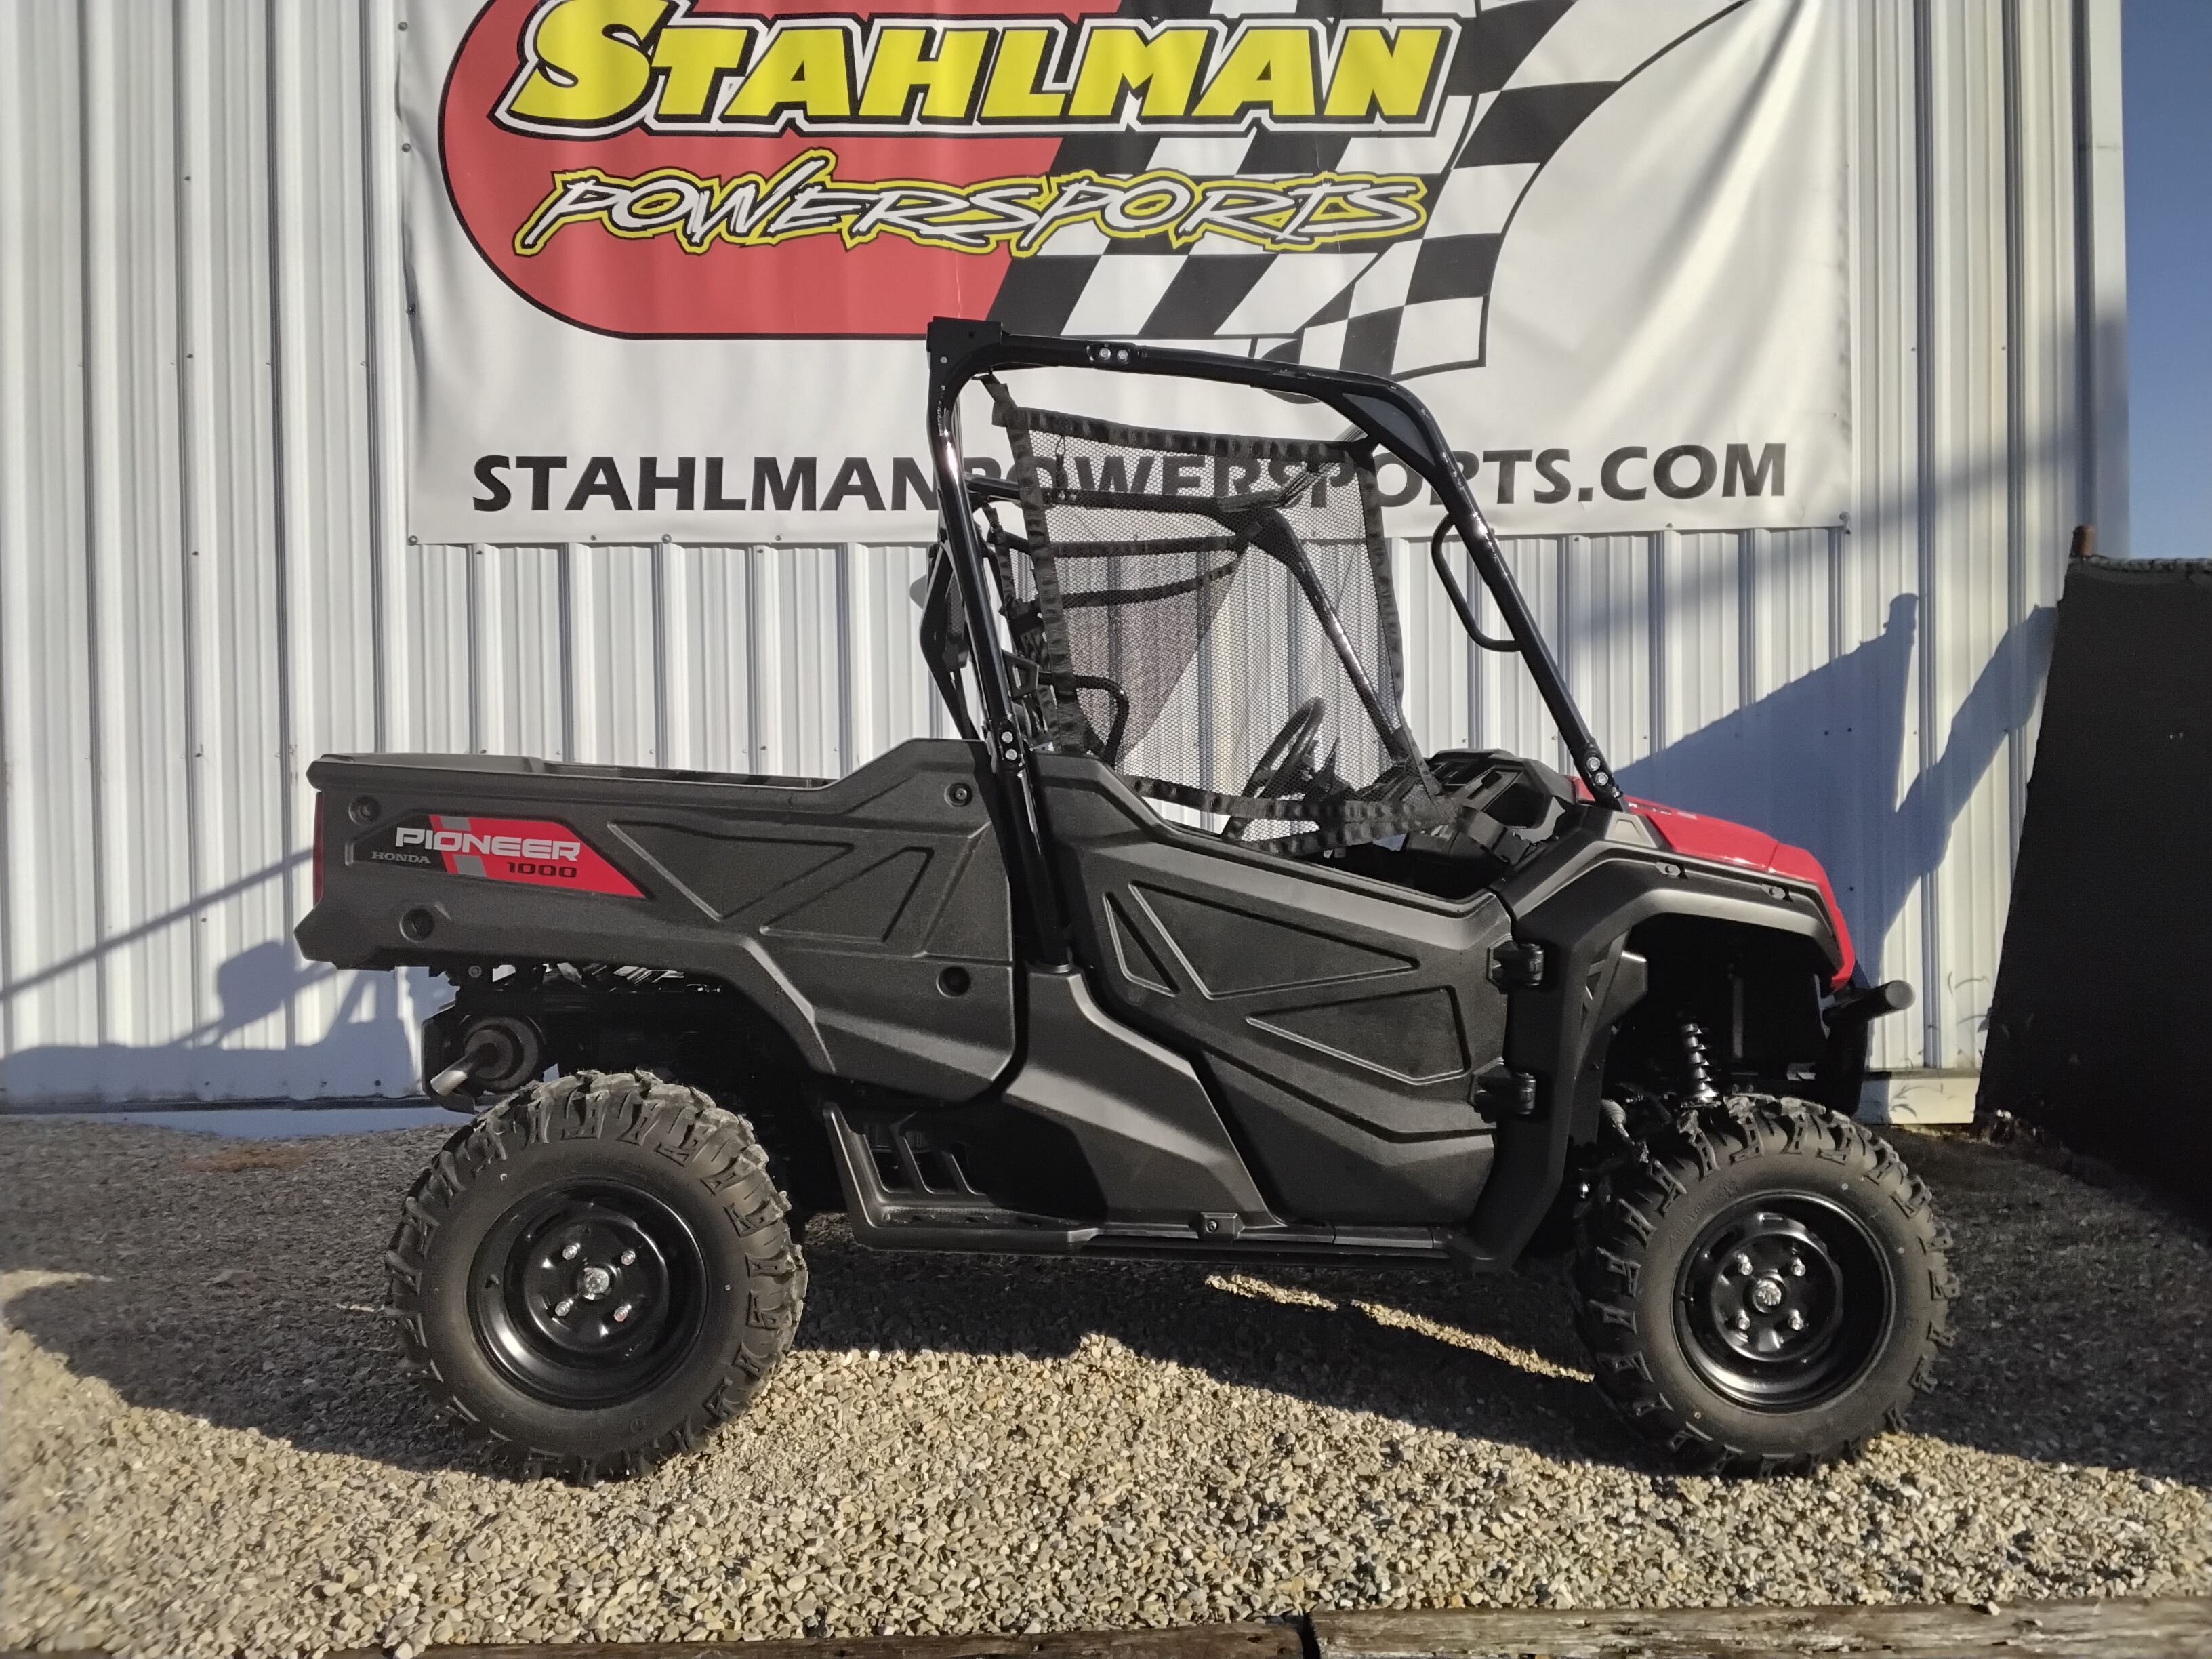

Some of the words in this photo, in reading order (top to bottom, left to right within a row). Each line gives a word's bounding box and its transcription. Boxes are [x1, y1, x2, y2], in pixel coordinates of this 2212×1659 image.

[498, 0, 1454, 125] STAHLMAN
[518, 153, 1425, 252] POWERSPORTS
[371, 851, 431, 865] HONDA
[395, 827, 581, 861] PIONEER
[506, 861, 577, 878] 1000
